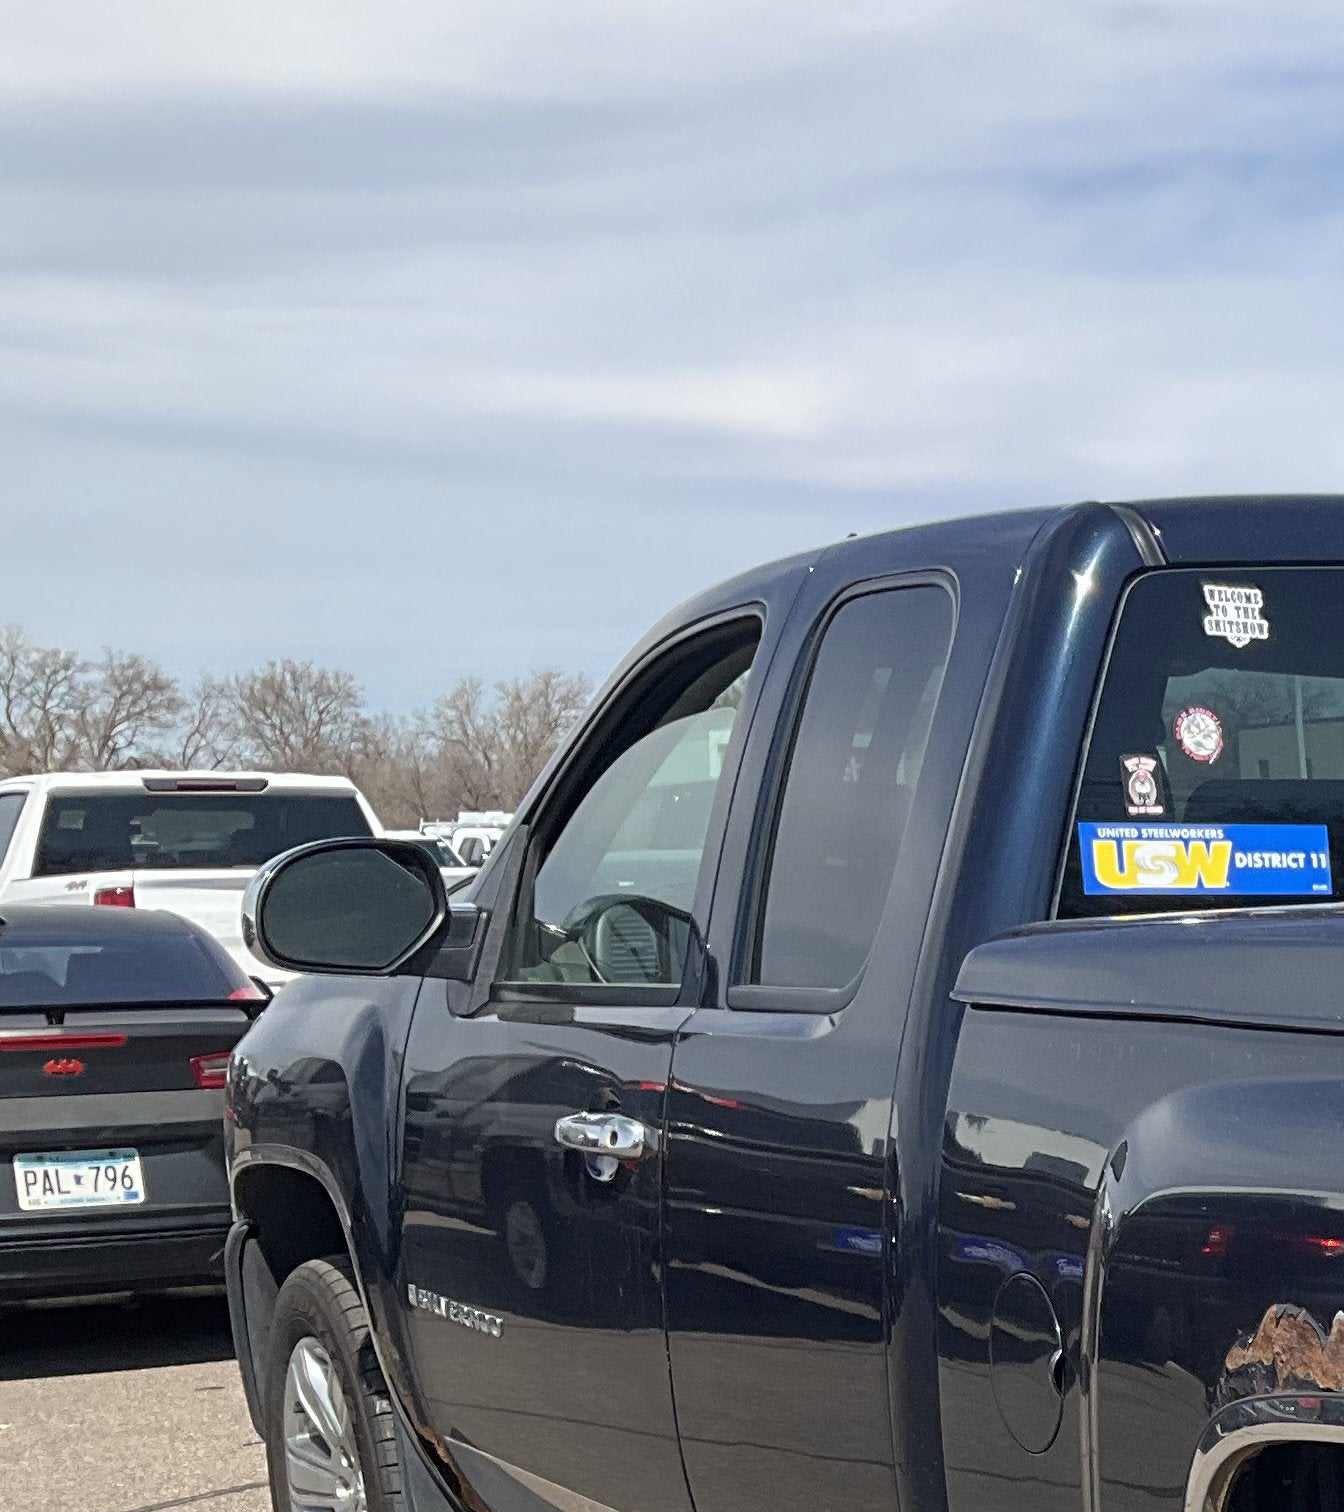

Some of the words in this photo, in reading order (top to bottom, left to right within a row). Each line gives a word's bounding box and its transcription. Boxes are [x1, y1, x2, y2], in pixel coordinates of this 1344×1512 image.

[1207, 589, 1260, 605] WELCOME
[1213, 604, 1228, 617] TO
[1234, 605, 1257, 620] THE
[1208, 619, 1265, 635] SHITSHOW
[1097, 827, 1139, 839] UNITED
[1141, 828, 1225, 840] STEELWORKERS
[1092, 840, 1233, 888] USW
[1234, 852, 1305, 869] DISTRICT
[1310, 852, 1327, 869] 11
[23, 1168, 72, 1197] PAL
[88, 1164, 134, 1192] 796
